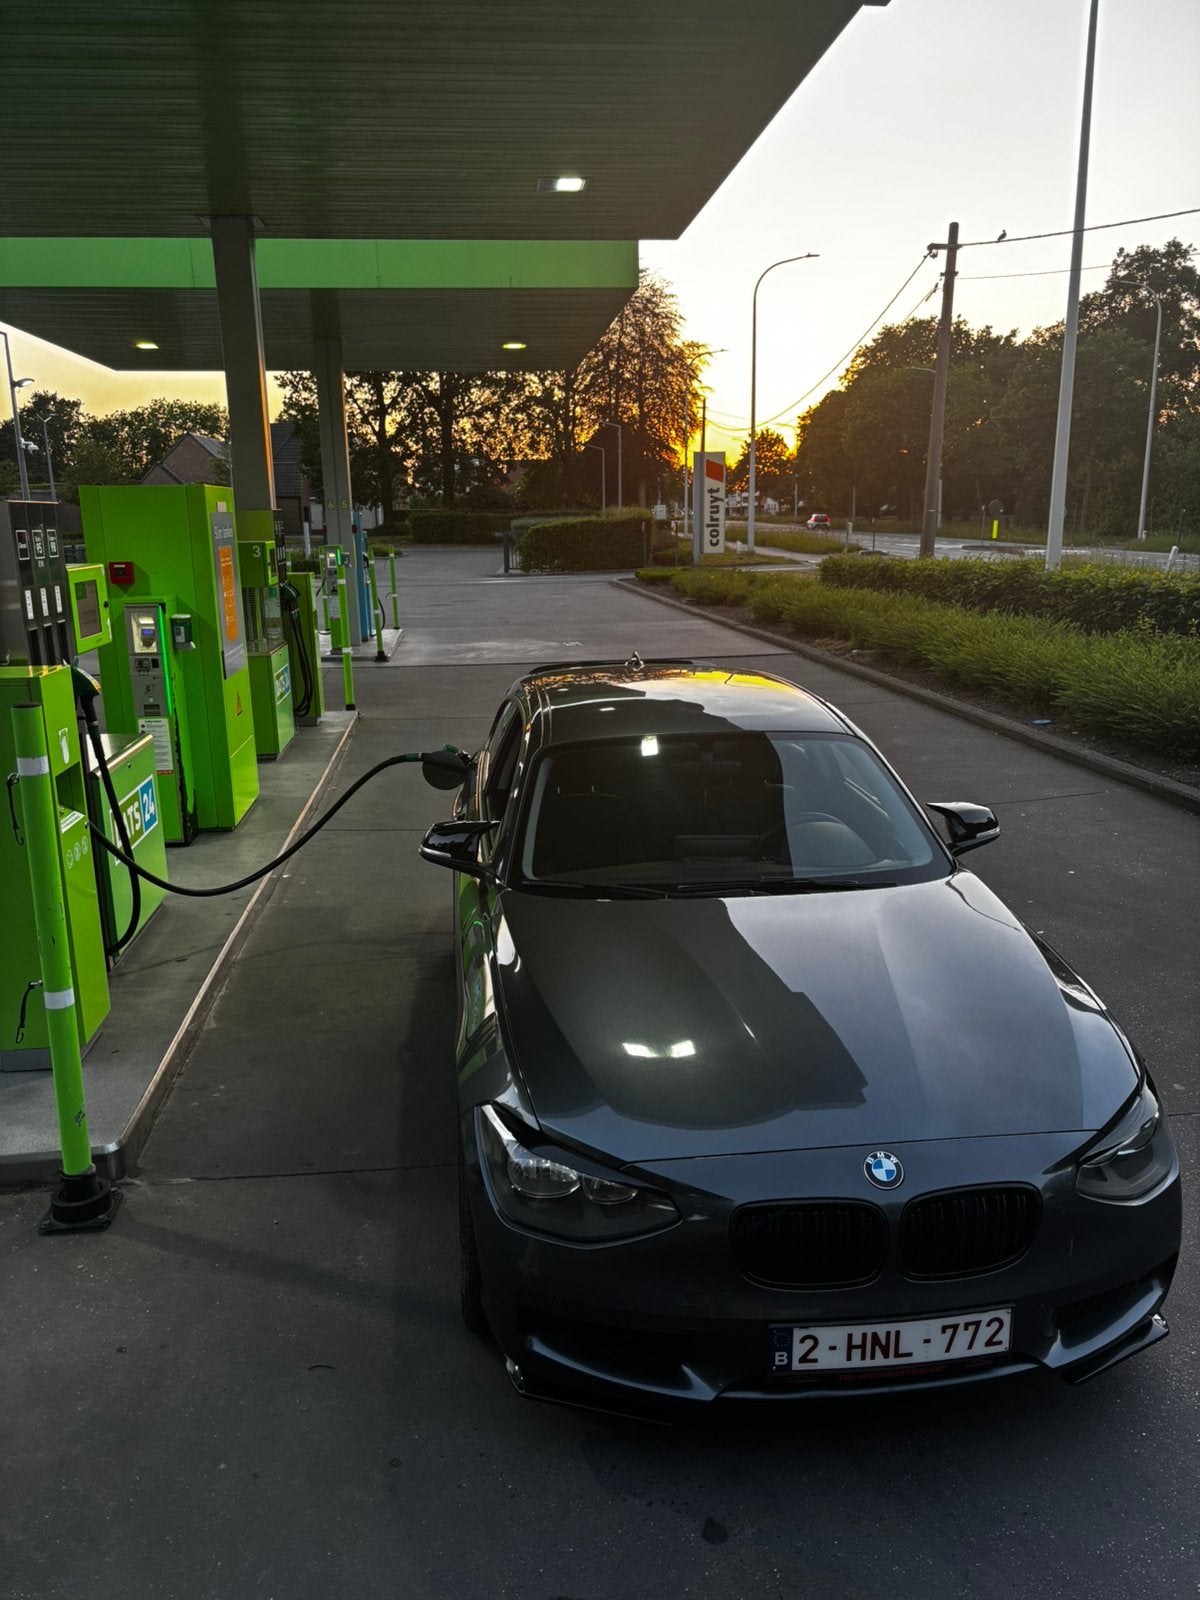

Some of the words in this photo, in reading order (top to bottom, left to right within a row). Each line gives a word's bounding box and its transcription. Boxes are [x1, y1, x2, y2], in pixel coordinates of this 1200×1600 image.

[327, 500, 335, 510] 6
[341, 500, 348, 510] 5
[706, 487, 724, 547] colruyt
[252, 545, 262, 558] 3
[143, 788, 155, 822] 24
[866, 1151, 899, 1165] BMW
[797, 1316, 1005, 1365] 2-HNL-772
[774, 1352, 788, 1366] B
